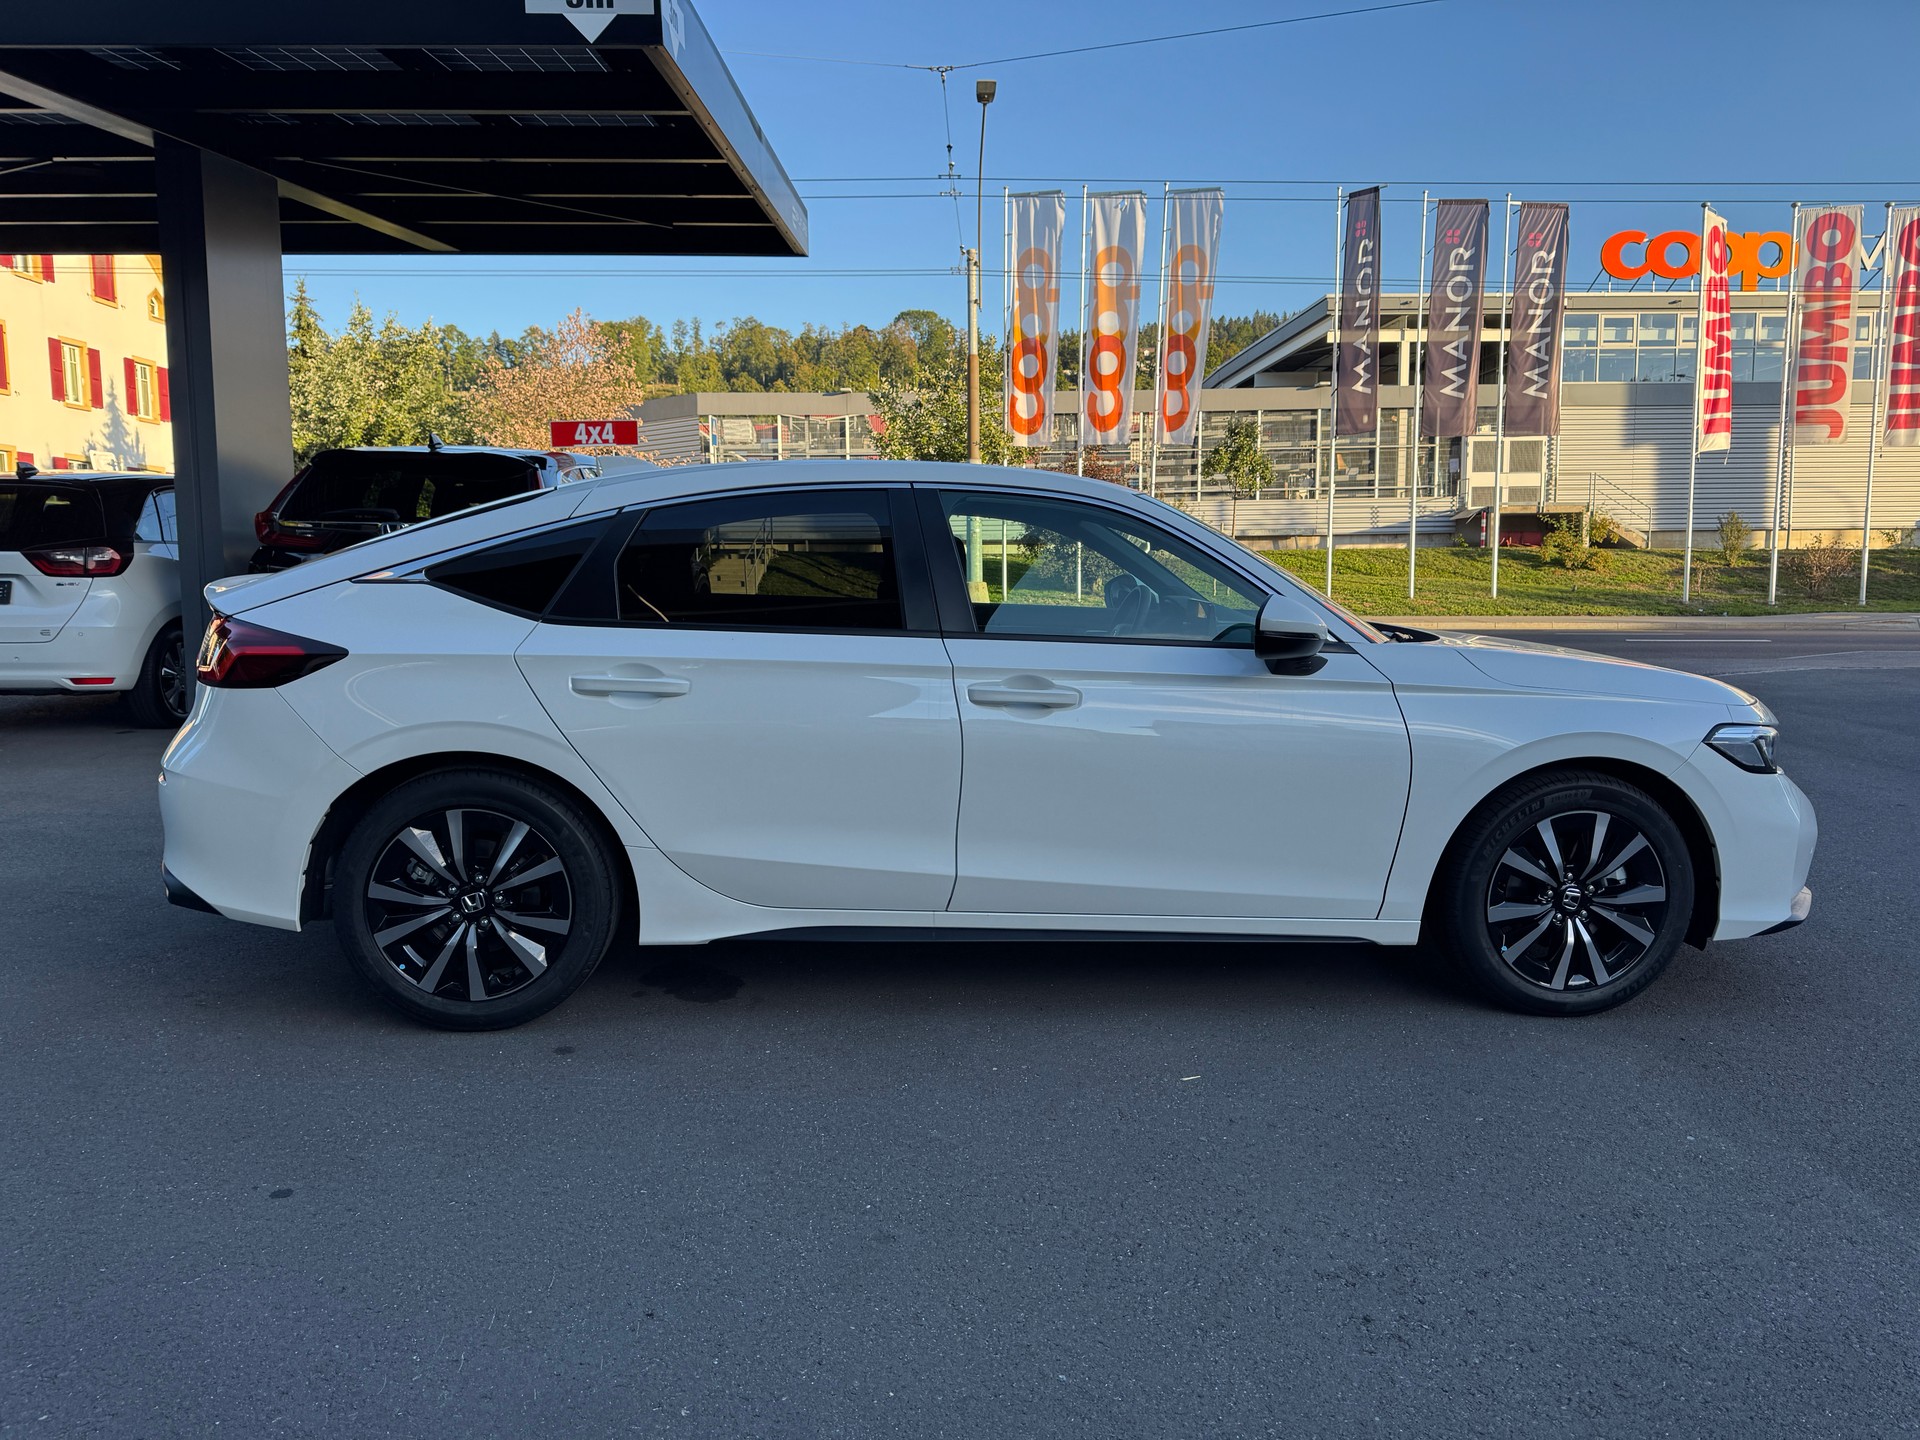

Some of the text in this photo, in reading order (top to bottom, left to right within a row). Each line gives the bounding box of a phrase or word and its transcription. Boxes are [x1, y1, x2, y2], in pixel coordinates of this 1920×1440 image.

[1009, 247, 1060, 436] coop
[1087, 245, 1141, 433] coop
[1163, 244, 1215, 433] coop
[1351, 238, 1374, 395] MANOR
[1439, 246, 1476, 399] MANOR
[1522, 249, 1556, 399] MANOR
[1795, 212, 1856, 439] JUMBO
[574, 422, 615, 444] 4x4
[1482, 799, 1542, 858] MICHELIN
